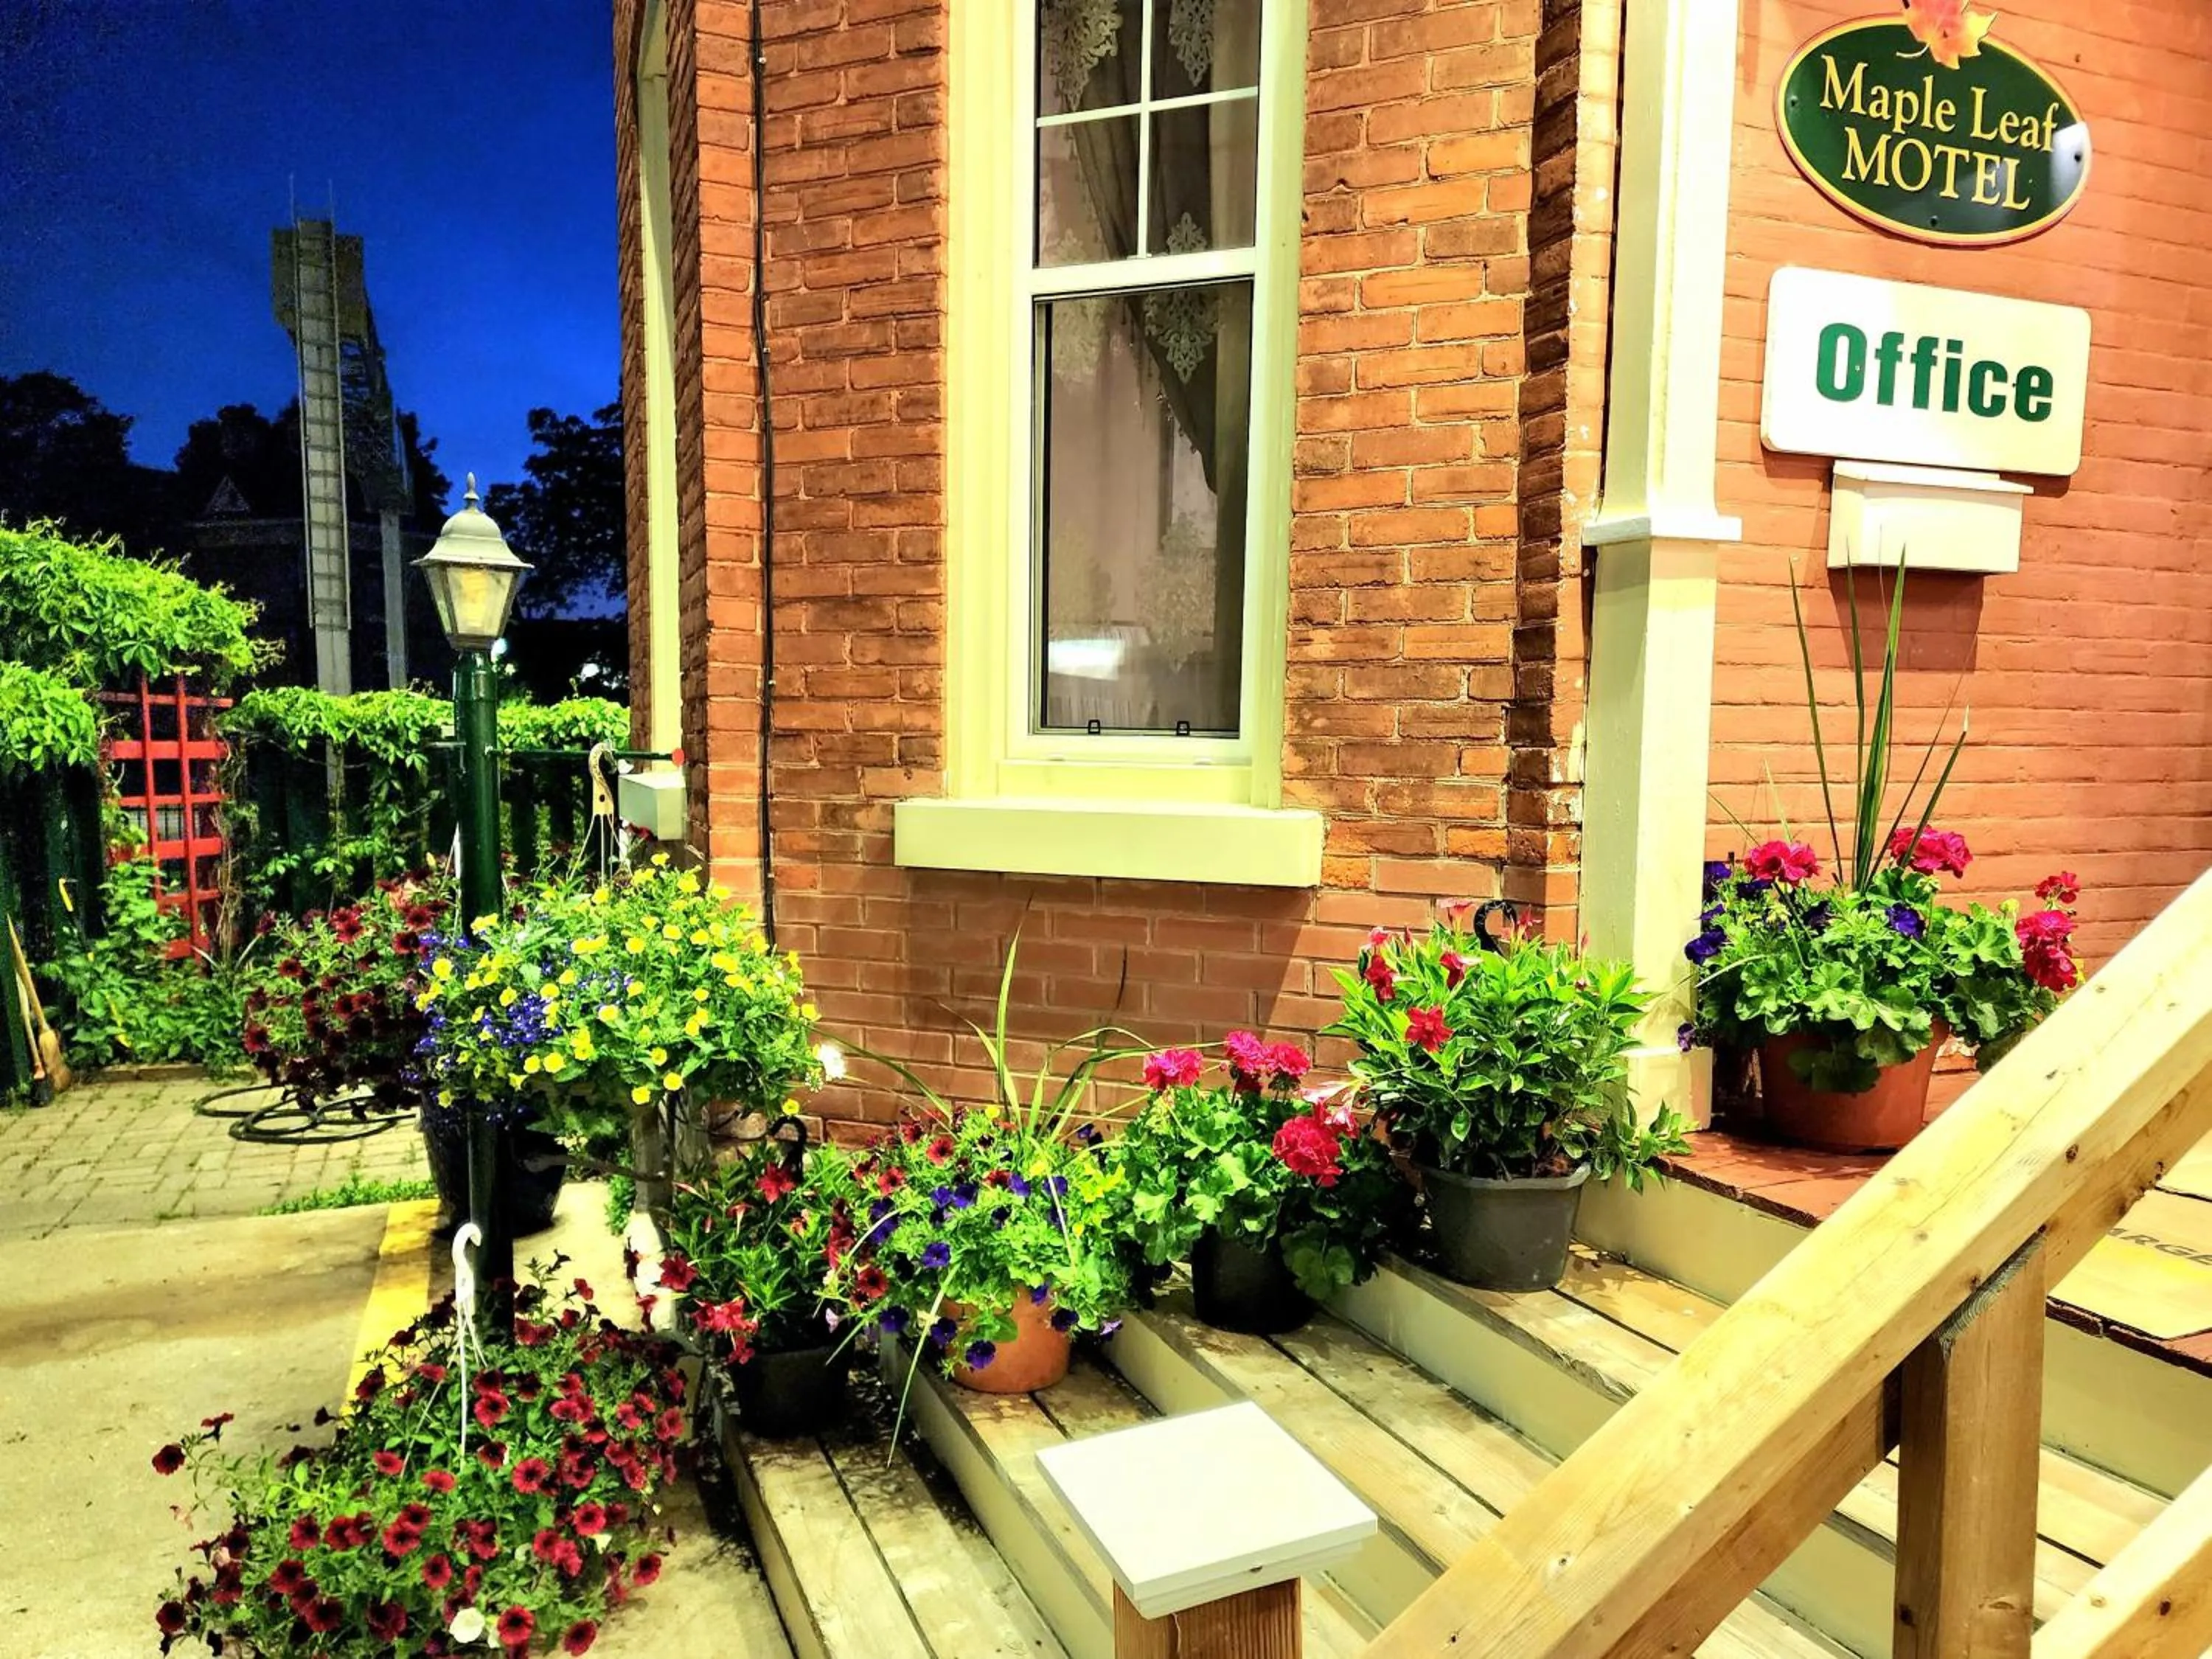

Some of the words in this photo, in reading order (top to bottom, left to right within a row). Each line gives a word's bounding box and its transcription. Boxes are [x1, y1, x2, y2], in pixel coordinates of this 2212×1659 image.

[1819, 54, 1956, 134] Maple
[1970, 86, 2059, 152] Leaf
[1841, 126, 2030, 210] MOTEL
[1816, 322, 2053, 422] Office
